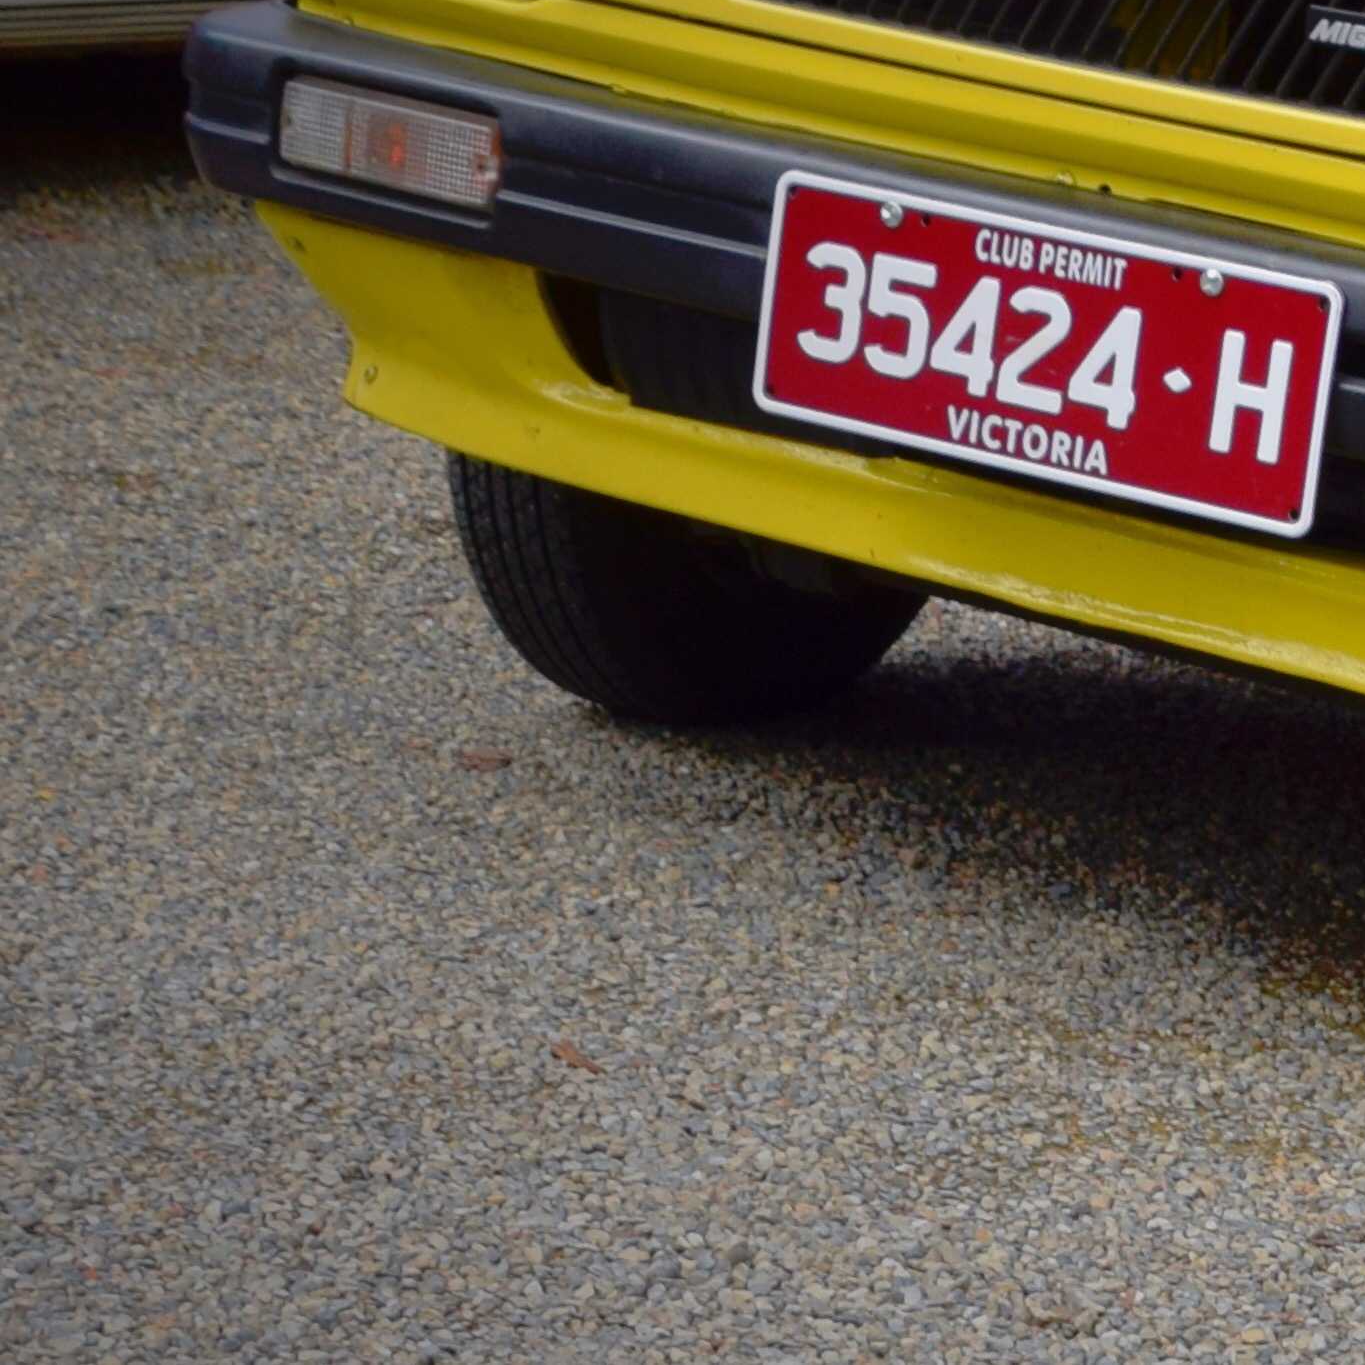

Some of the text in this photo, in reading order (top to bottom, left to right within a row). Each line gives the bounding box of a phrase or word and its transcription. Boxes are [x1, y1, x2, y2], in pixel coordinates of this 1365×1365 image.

[975, 228, 1128, 291] CLUB PERMIT
[947, 404, 1108, 476] VICTORIA
